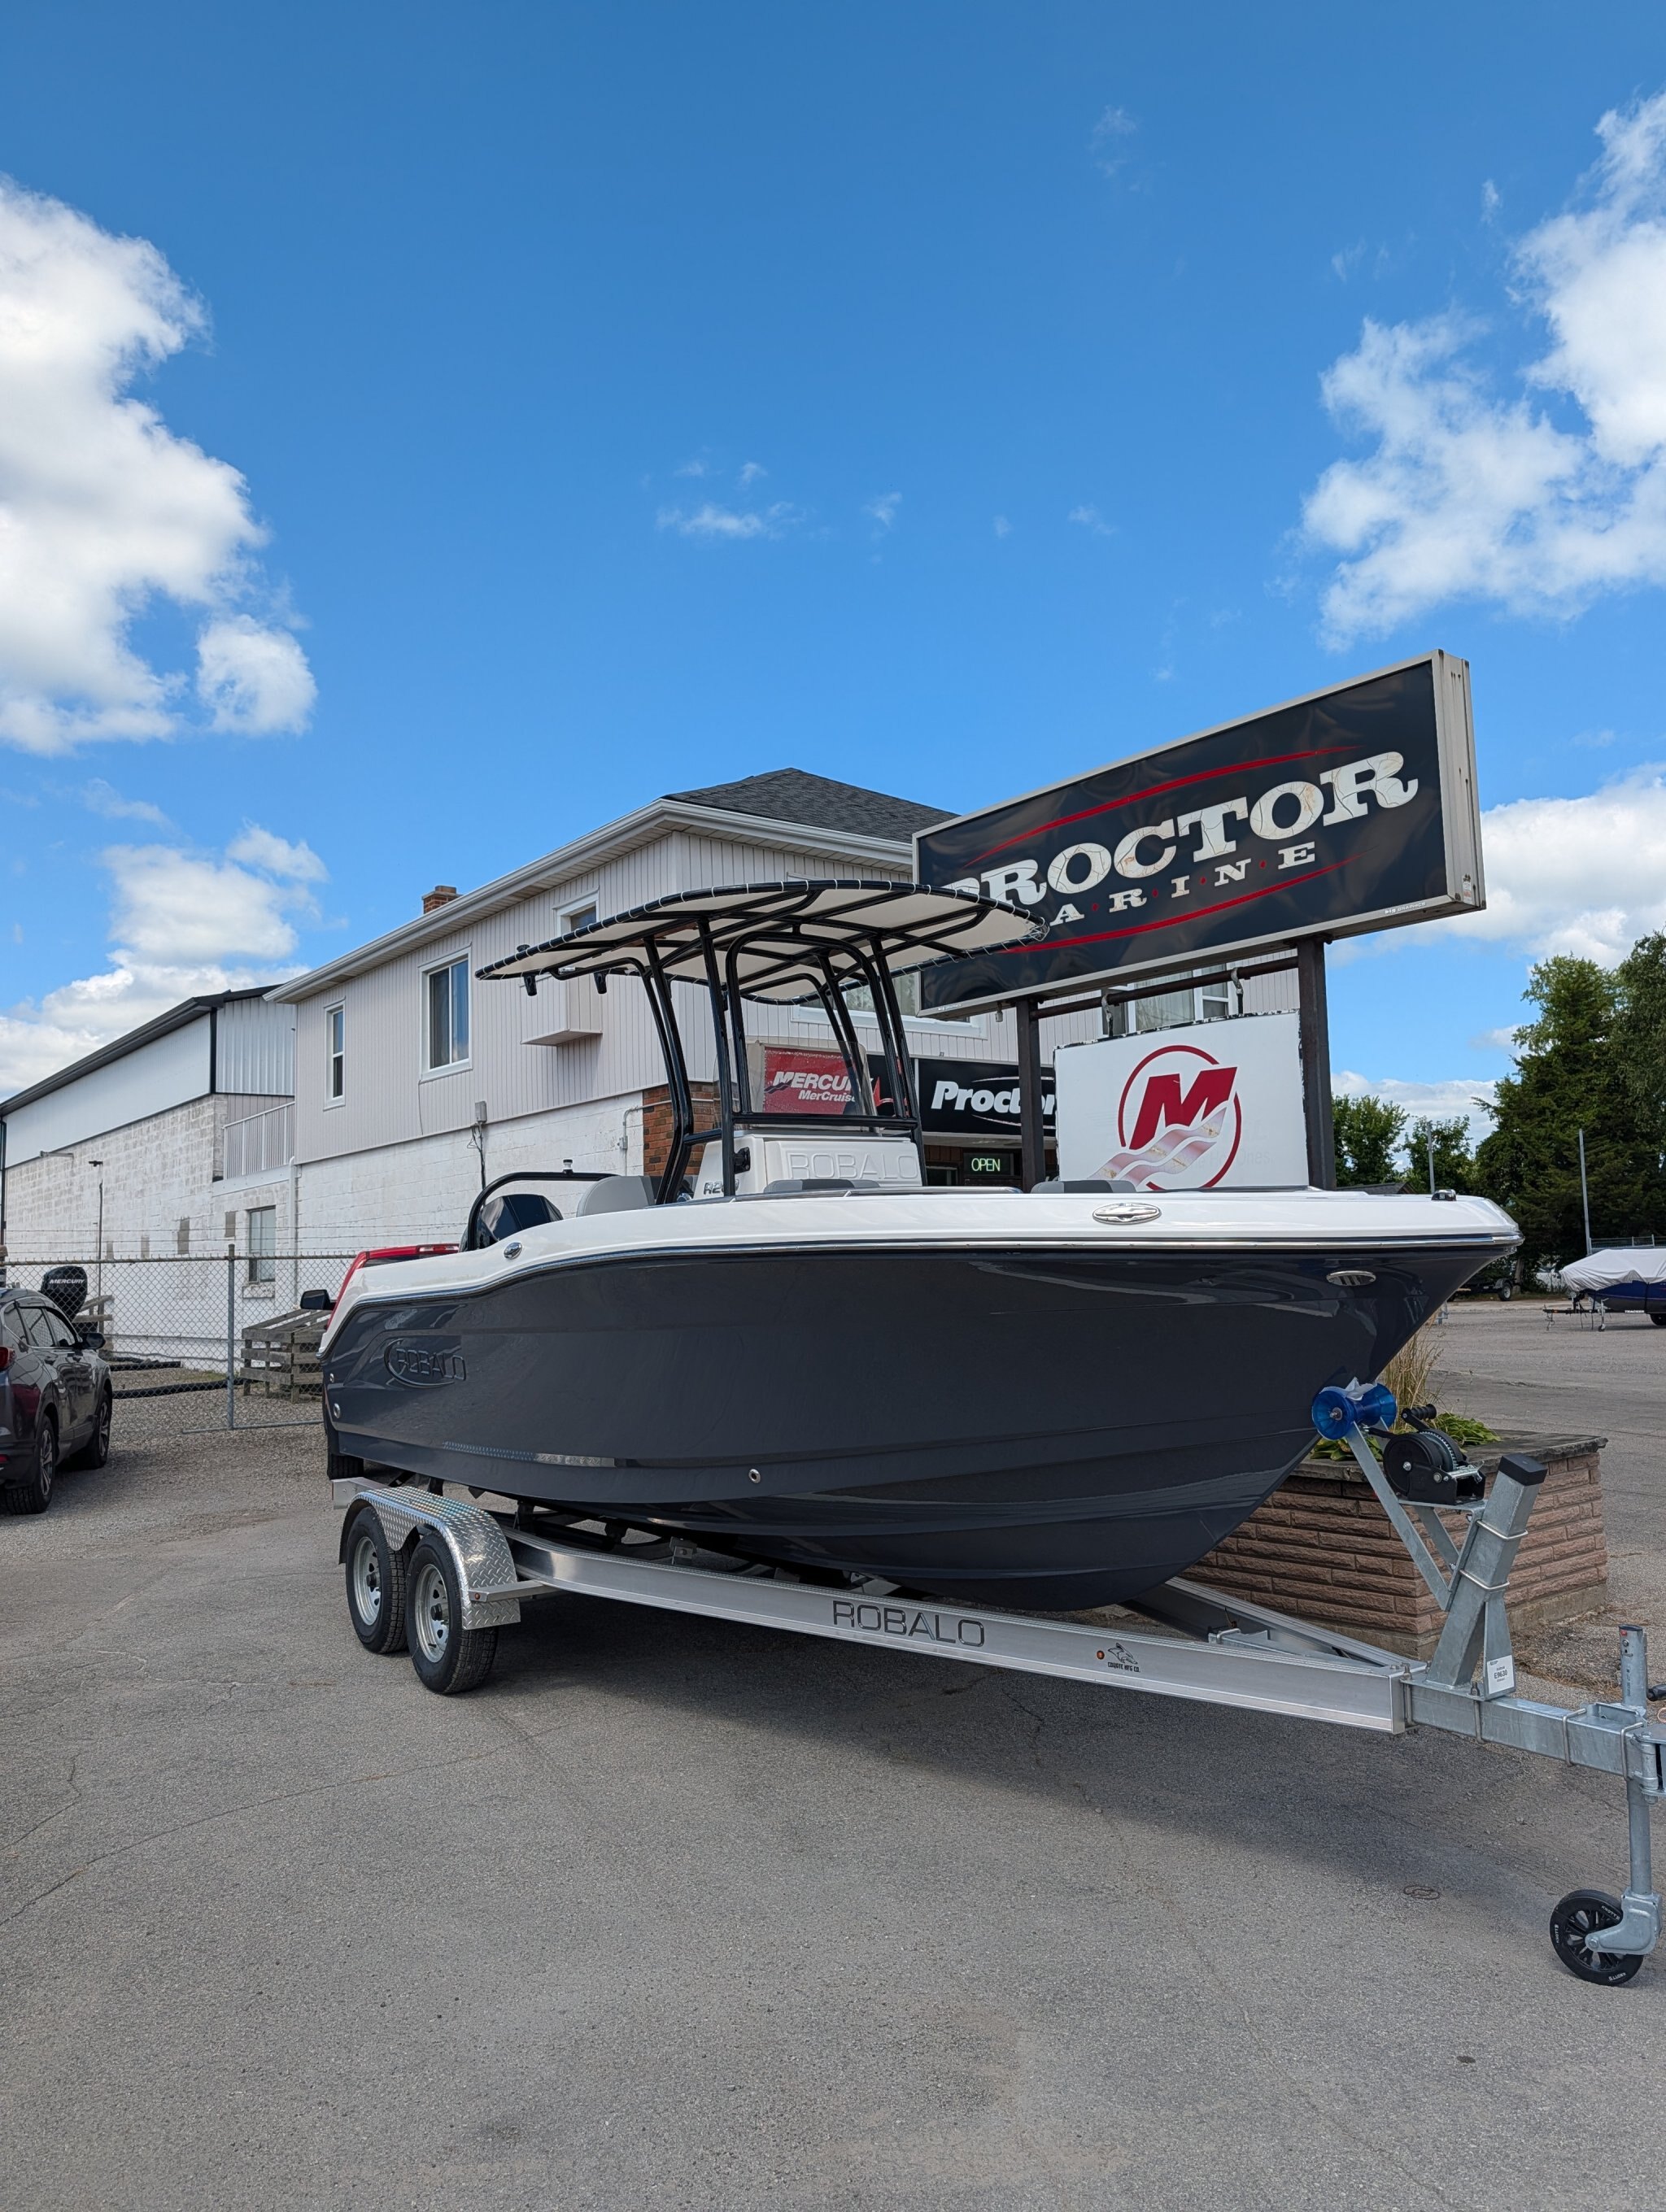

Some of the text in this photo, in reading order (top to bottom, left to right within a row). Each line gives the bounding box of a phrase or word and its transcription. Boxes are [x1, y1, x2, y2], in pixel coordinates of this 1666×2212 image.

[798, 1090, 856, 1102] MerCruis
[931, 1080, 1055, 1115] Proctr
[787, 1152, 918, 1180] ROBALO
[971, 1157, 1001, 1172] OPEN
[833, 1600, 985, 1648] ROBALO
